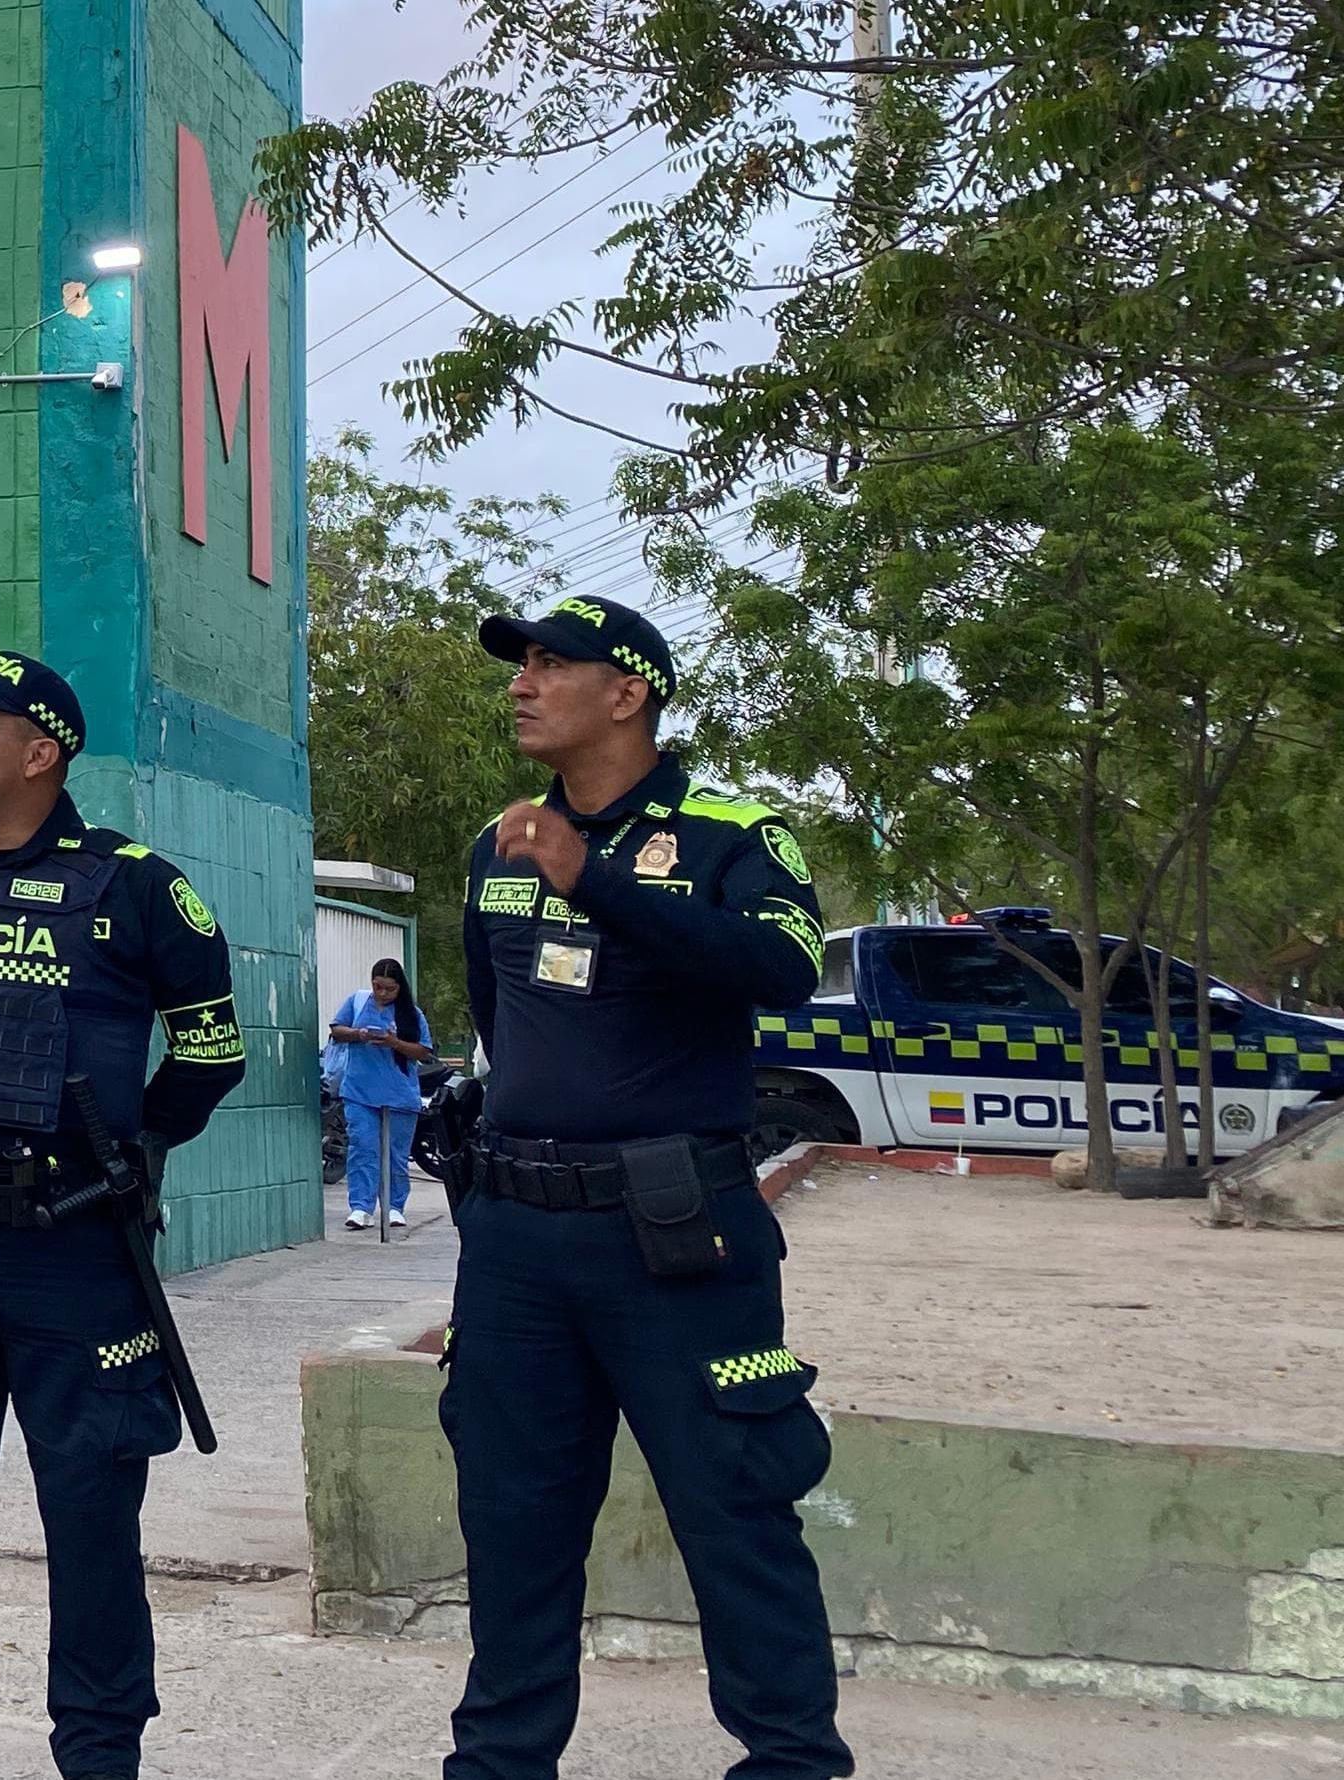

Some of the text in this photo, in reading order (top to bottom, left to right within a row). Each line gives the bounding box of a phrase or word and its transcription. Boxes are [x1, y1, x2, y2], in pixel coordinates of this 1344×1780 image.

[177, 122, 272, 588] M
[14, 882, 60, 898] 148126
[175, 1022, 237, 1045] POLICIA
[973, 1087, 1201, 1133] POLCÍA
